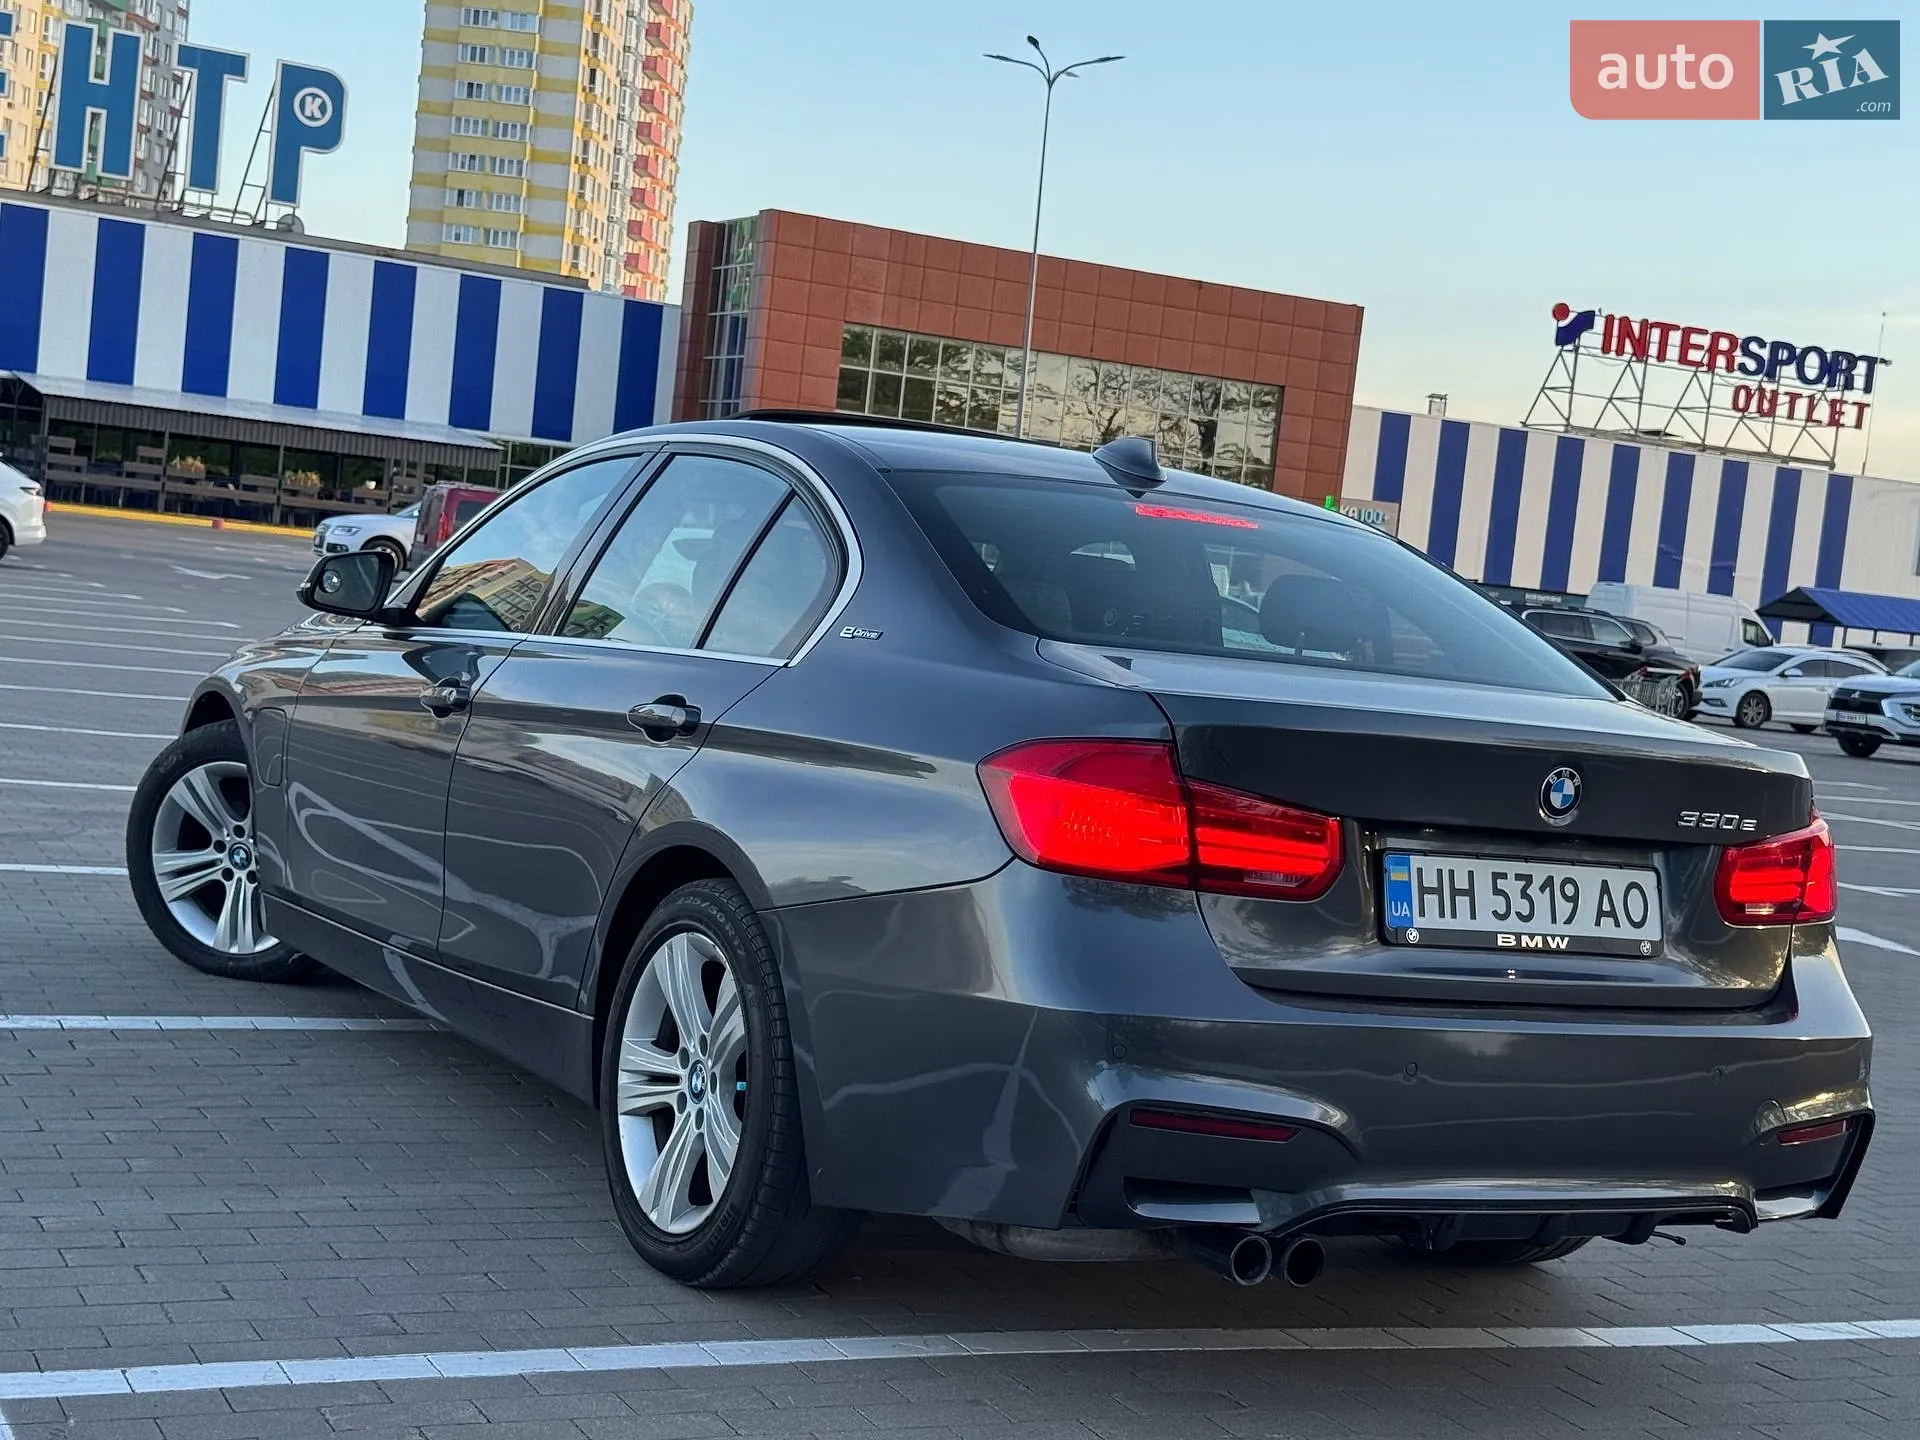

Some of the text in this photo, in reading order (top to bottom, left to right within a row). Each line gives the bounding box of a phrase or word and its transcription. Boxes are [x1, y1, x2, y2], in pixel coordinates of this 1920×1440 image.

[1601, 314, 1879, 394] INTERSPORT
[1731, 384, 1871, 430] OUTLET
[1549, 769, 1581, 787] BMW
[1391, 900, 1411, 917] UA
[1417, 867, 1649, 930] HH 5319 AO
[1496, 933, 1570, 950] BMW
